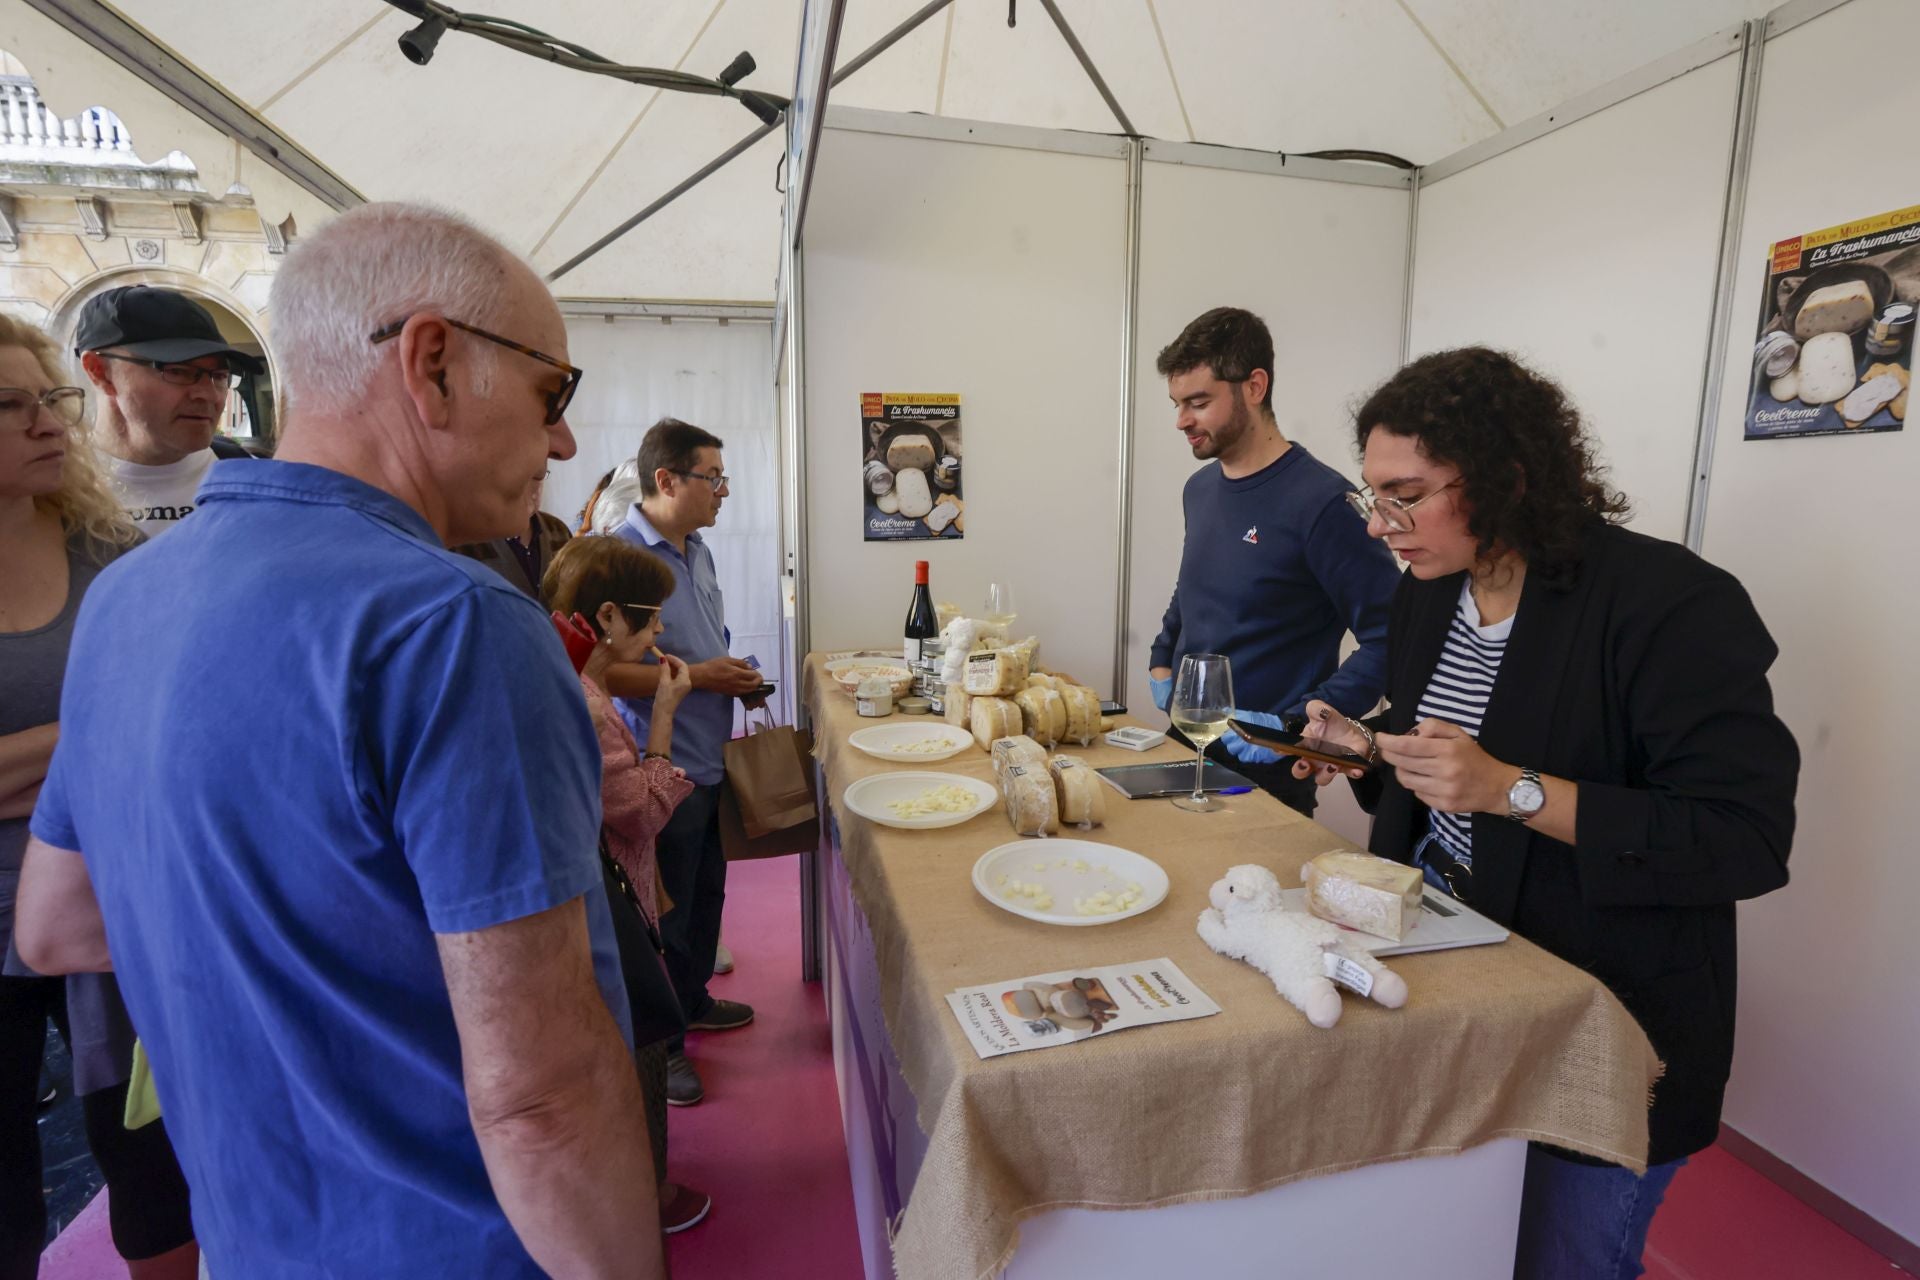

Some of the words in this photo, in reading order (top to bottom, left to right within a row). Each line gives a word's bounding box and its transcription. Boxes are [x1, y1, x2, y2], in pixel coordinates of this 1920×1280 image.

[1840, 224, 1870, 237] MULO
[1810, 248, 1828, 261] La
[1829, 226, 1920, 256] Trashumancia
[890, 406, 902, 415] La
[903, 405, 956, 418] Trashumancia
[1755, 407, 1821, 423] CeciCrema
[129, 506, 194, 521] oma
[869, 518, 916, 528] CeciCrema
[973, 992, 992, 1008] Real
[988, 1008, 1012, 1038] Moldera
[1008, 1037, 1021, 1047] La
